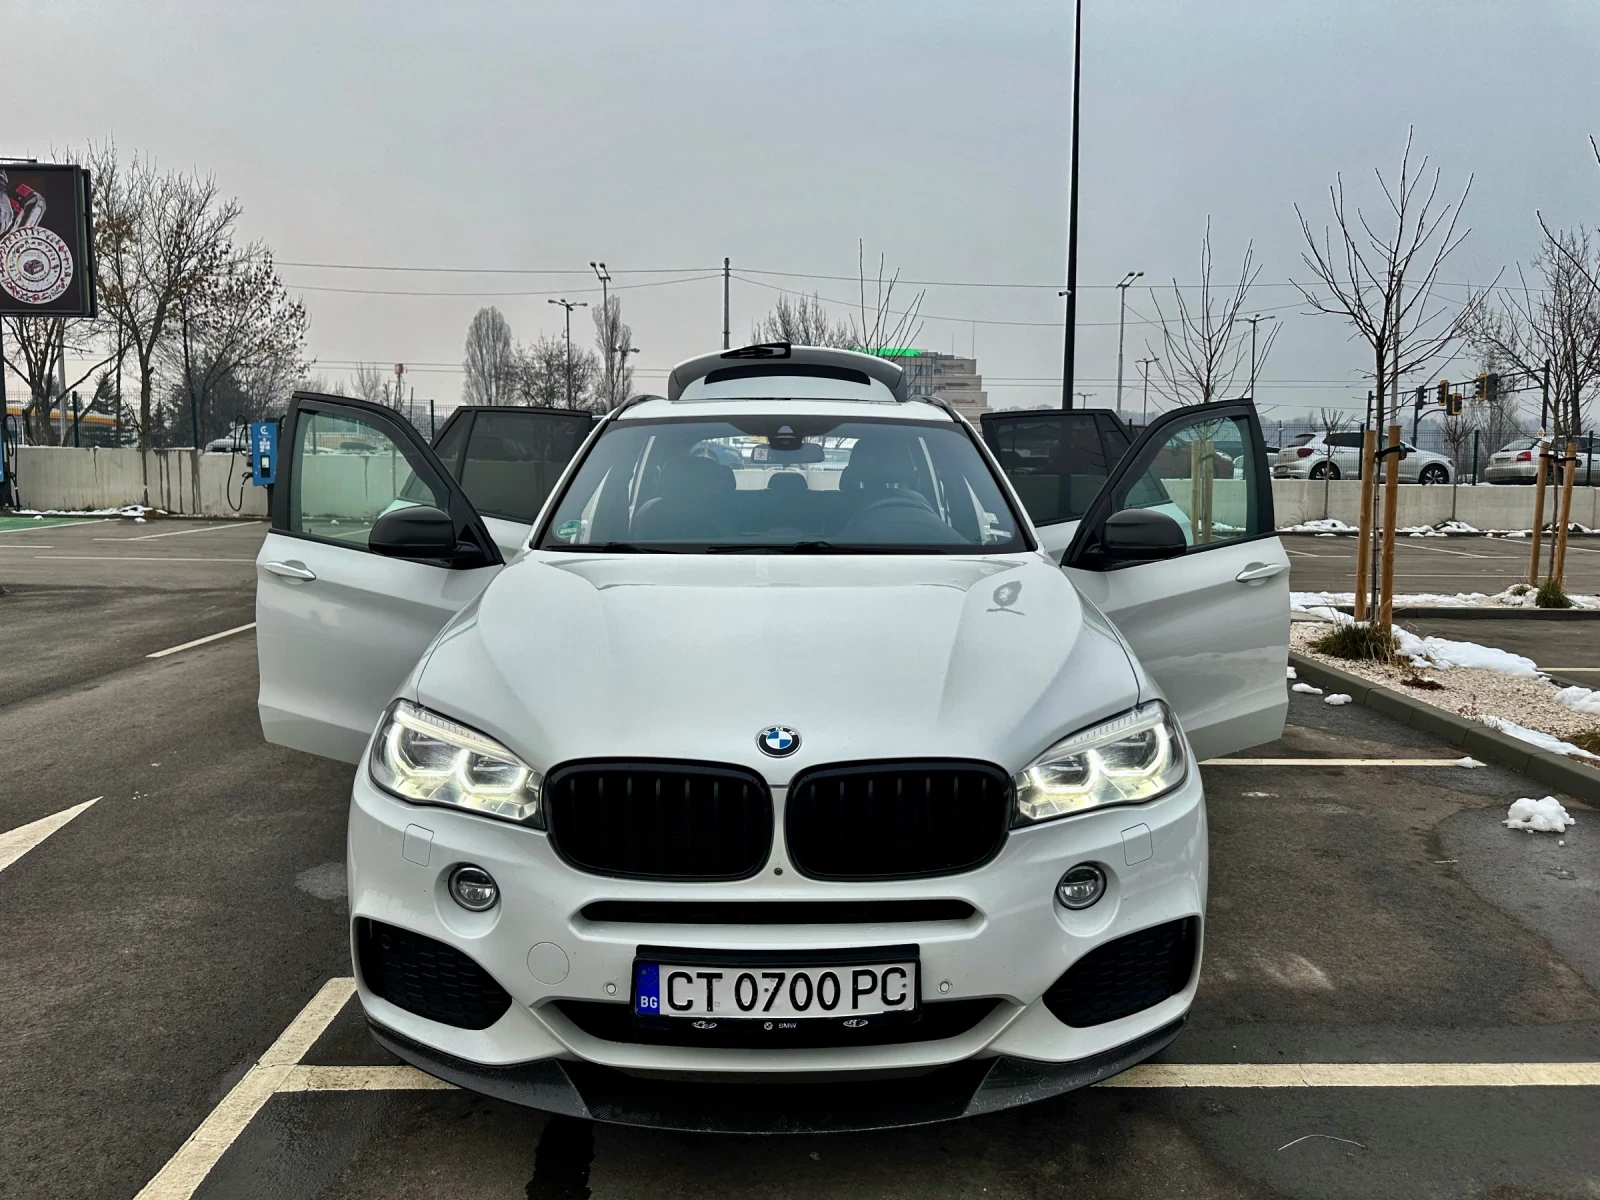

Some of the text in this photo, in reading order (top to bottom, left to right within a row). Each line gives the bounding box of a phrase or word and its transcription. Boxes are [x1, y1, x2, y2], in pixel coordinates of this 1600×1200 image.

[640, 995, 658, 1009] BG
[667, 966, 907, 1012] CT 0700 PC
